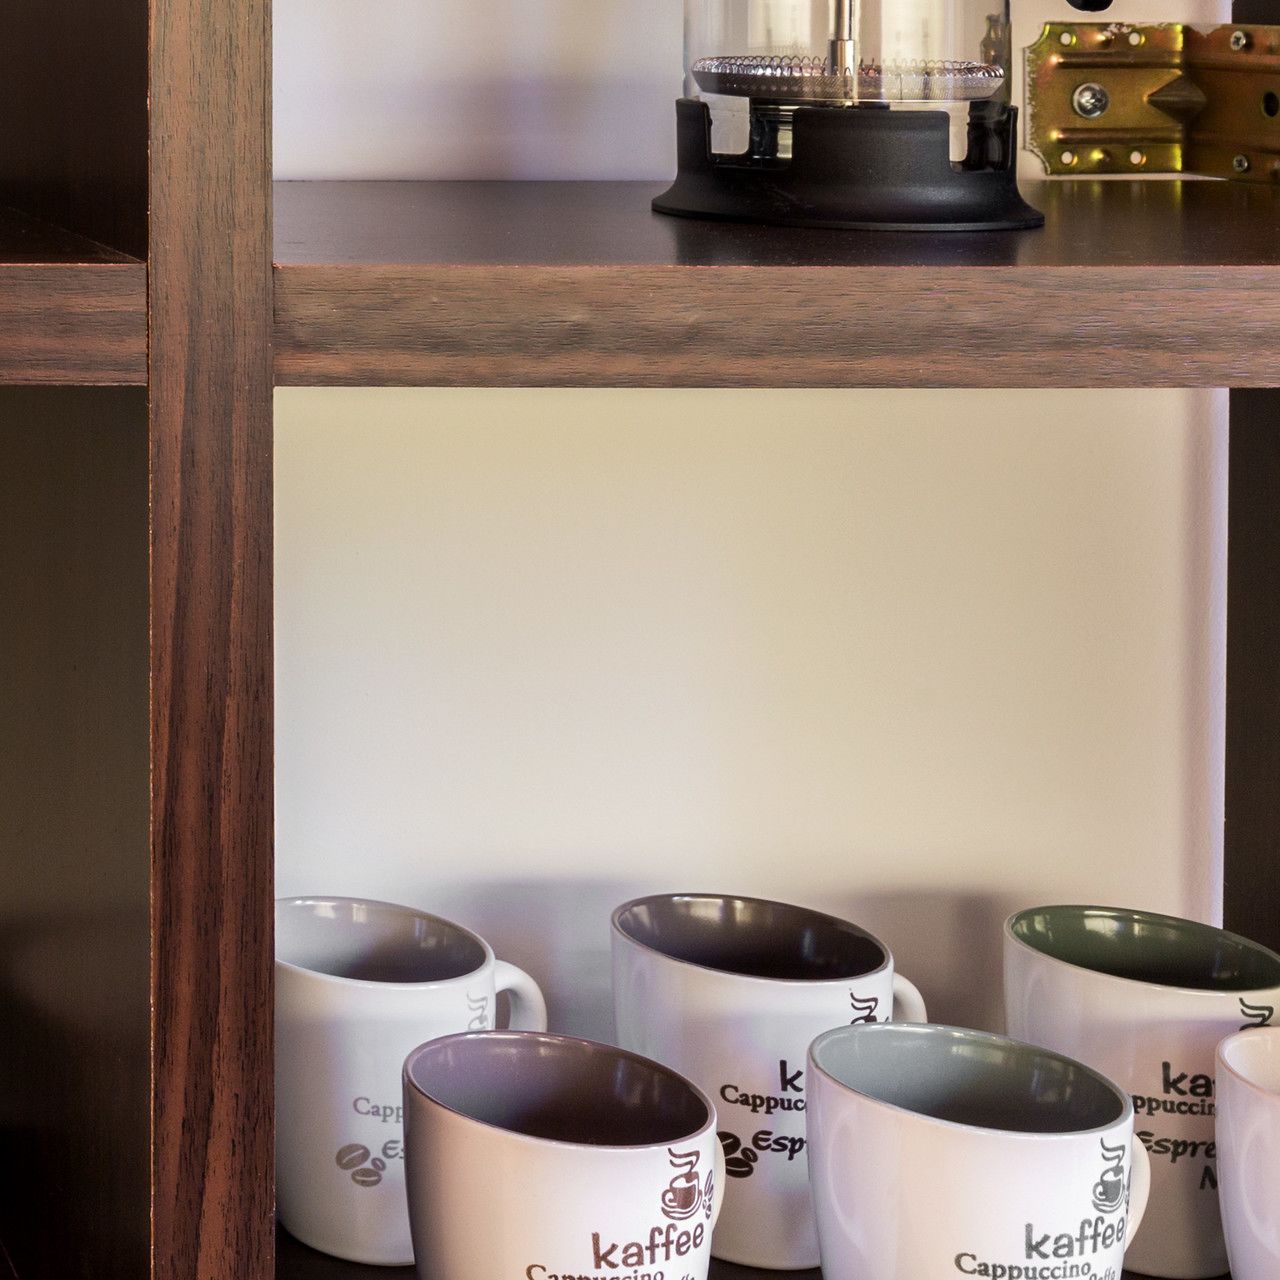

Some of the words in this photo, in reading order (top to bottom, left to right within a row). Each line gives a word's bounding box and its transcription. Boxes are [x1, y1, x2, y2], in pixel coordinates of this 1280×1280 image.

[780, 1059, 803, 1092] k
[1162, 1061, 1216, 1097] ka
[720, 1084, 806, 1115] Cappuc
[752, 1130, 806, 1161] Esp
[591, 1222, 705, 1269] kaffee
[1025, 1216, 1124, 1260] kaffee
[954, 1252, 1091, 1280] Cappuccino
